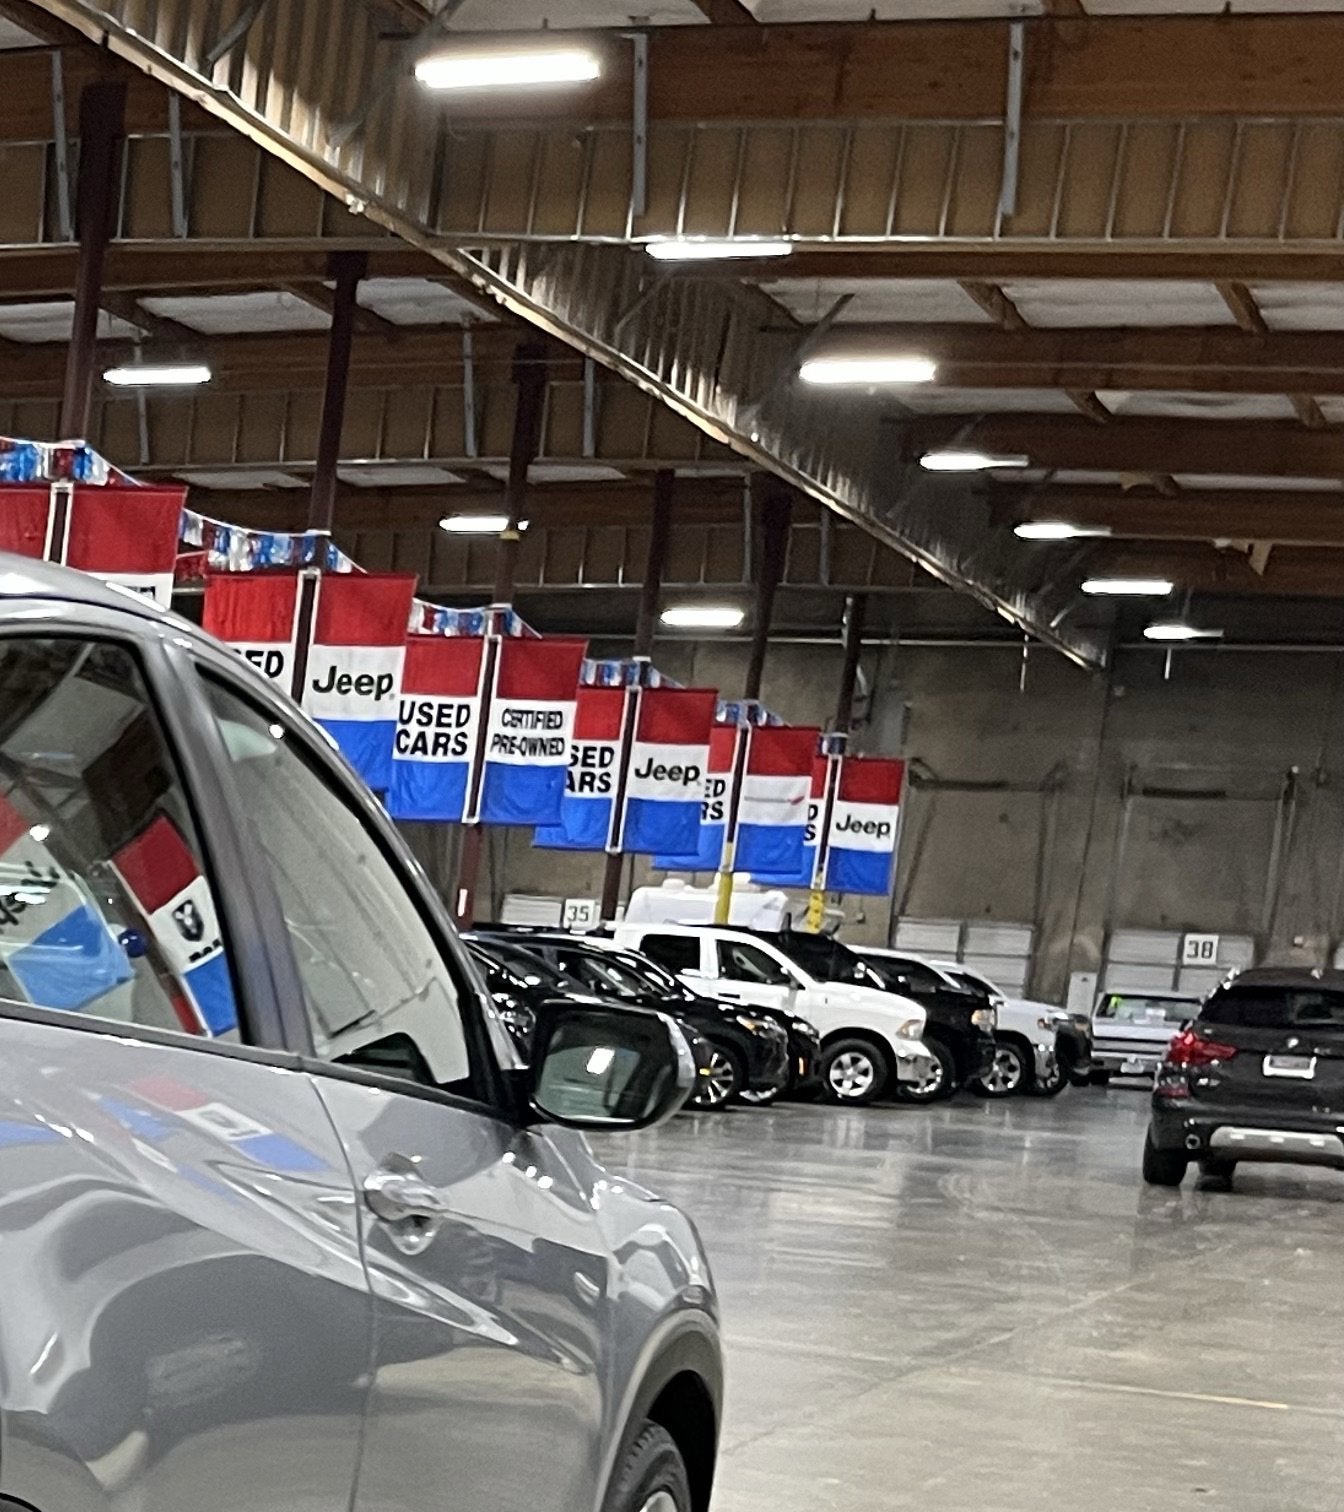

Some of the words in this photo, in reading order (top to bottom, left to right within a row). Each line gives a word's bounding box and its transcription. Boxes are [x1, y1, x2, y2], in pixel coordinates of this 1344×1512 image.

[312, 665, 394, 701] Jeep
[398, 700, 471, 729] USED
[501, 708, 563, 730] CERTIFIED
[395, 729, 469, 757] CARS
[490, 733, 565, 757] PRE-OWNED
[570, 744, 615, 769] SED
[566, 771, 612, 793] ARS
[634, 757, 701, 786] Jeep
[835, 815, 892, 839] Jeep
[567, 905, 589, 922] 35
[1186, 940, 1214, 959] 38
